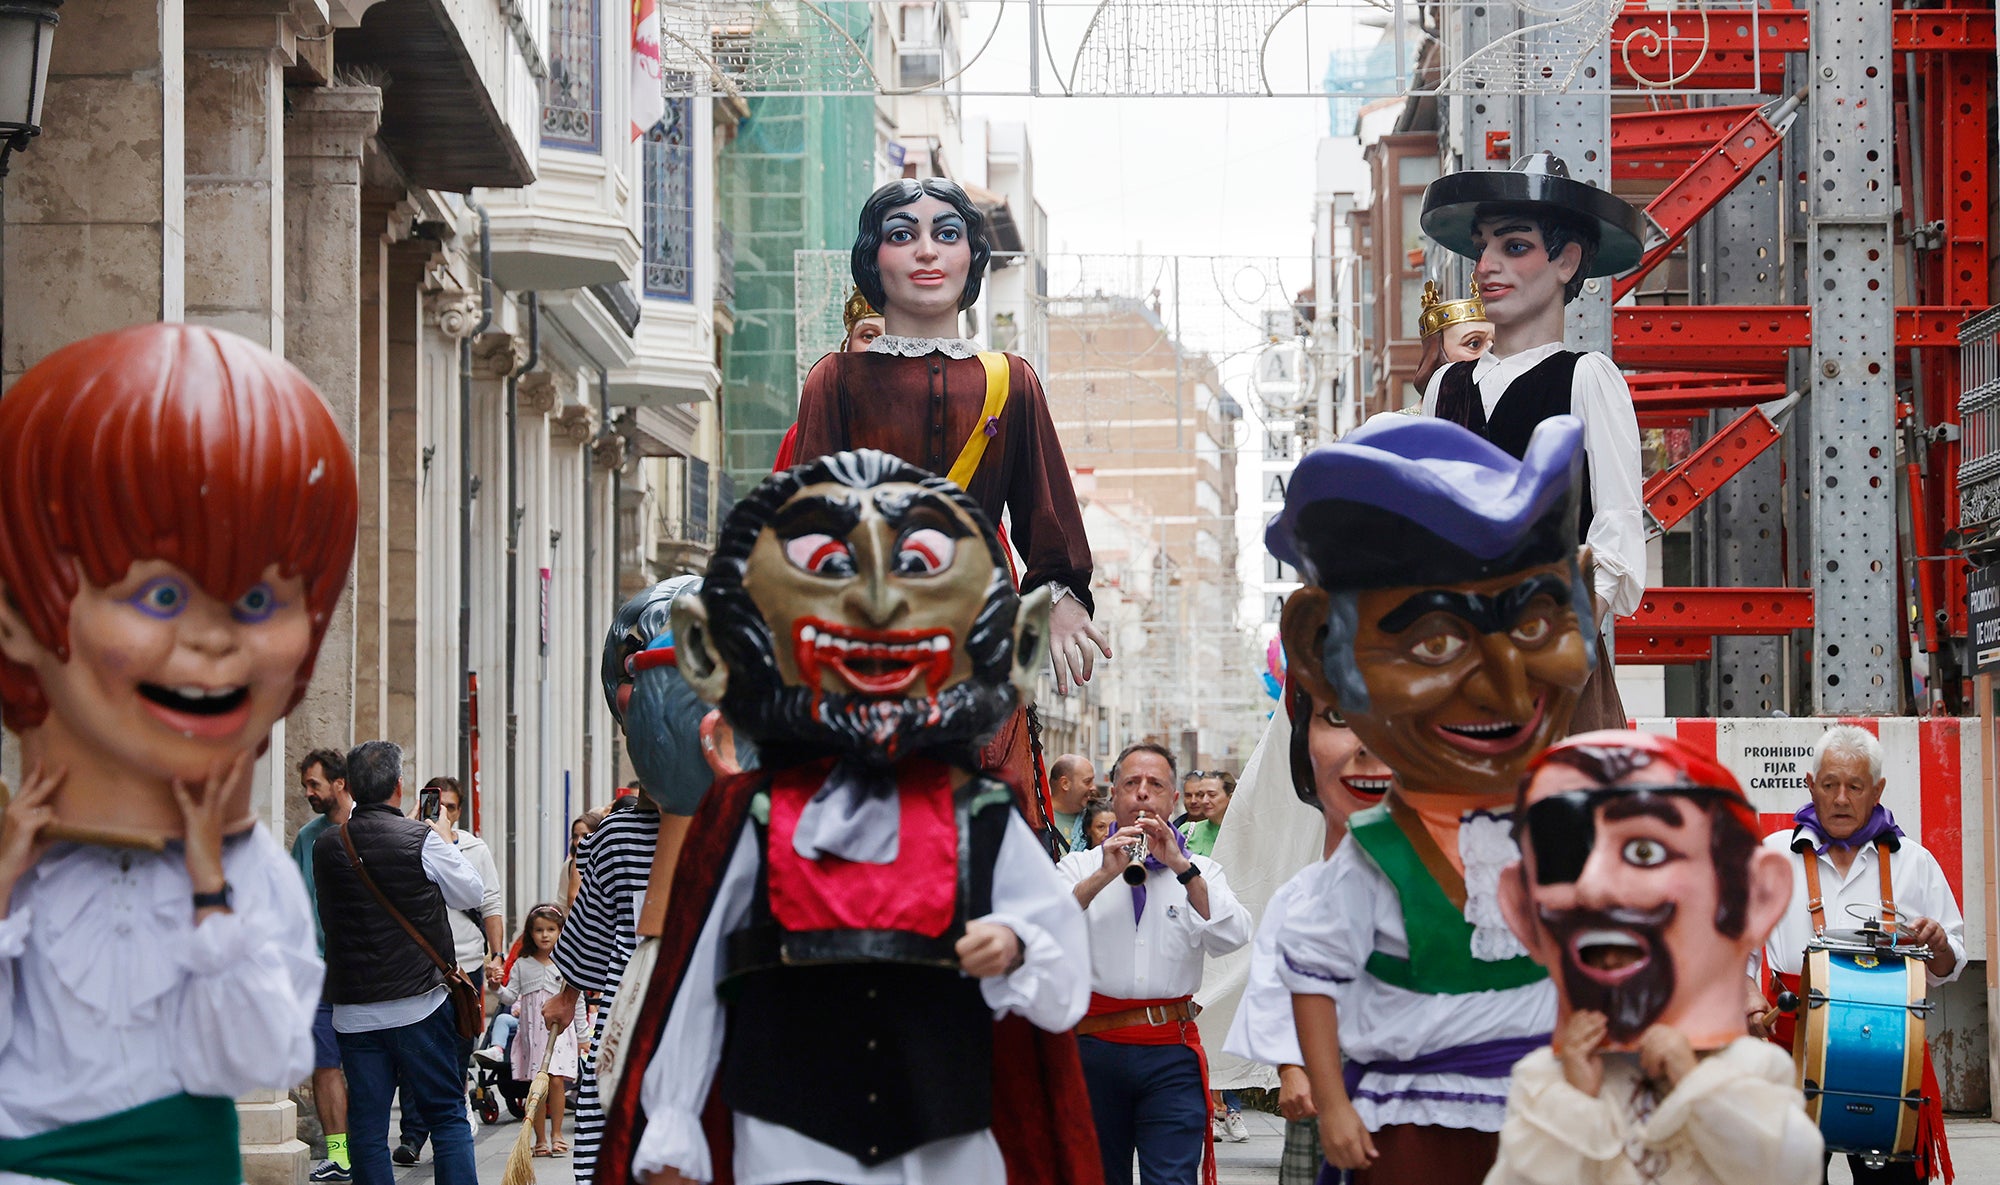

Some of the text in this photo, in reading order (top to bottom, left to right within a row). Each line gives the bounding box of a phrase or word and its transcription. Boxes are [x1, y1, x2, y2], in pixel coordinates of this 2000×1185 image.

[1976, 622, 1984, 645] DE
[1744, 746, 1815, 758] PROHIBIDO
[1764, 762, 1796, 776] FIJAR
[1750, 777, 1809, 789] CARTELES
